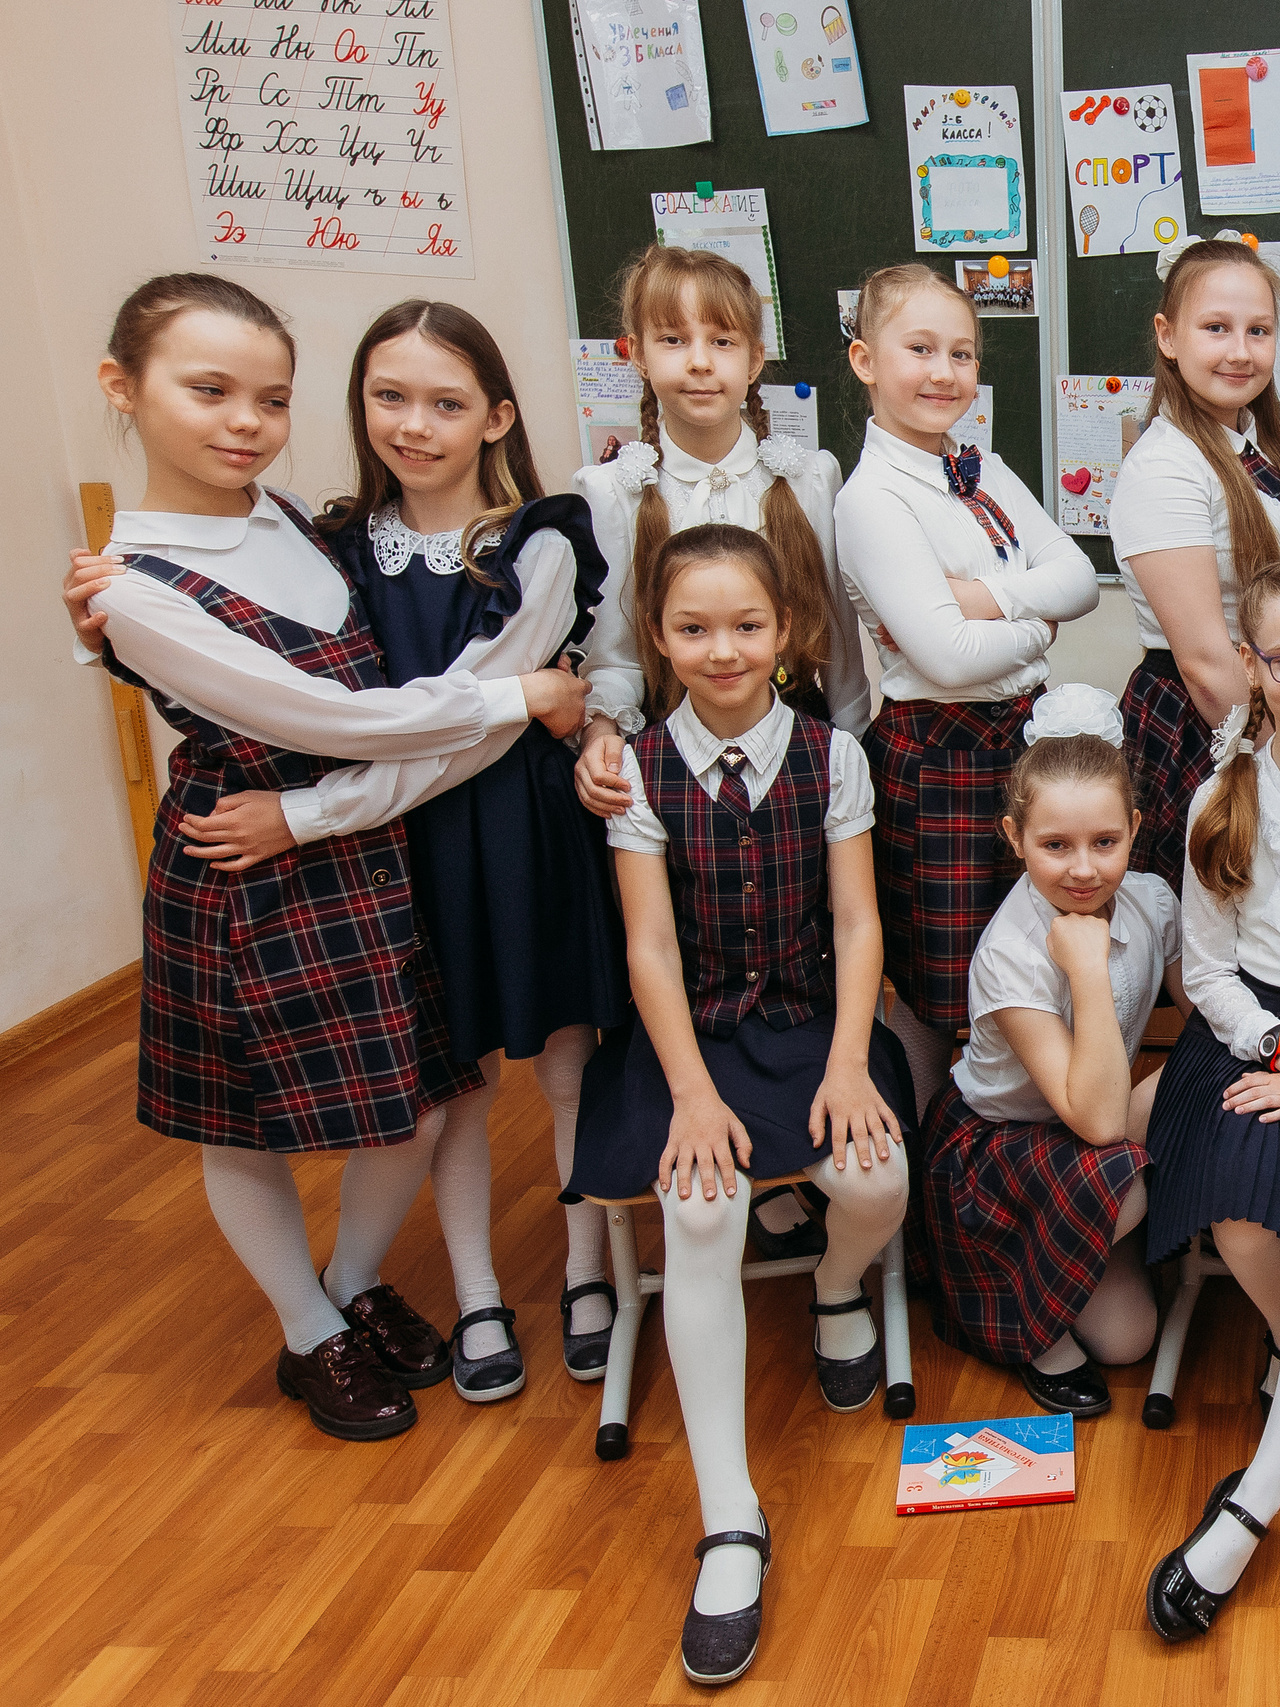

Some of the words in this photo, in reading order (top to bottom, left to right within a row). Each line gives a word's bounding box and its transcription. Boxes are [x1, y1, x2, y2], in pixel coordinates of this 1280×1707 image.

[186, 20, 251, 56] Мм
[270, 24, 315, 60] Нн
[334, 28, 369, 63] Оо
[388, 31, 439, 68] Пп
[619, 45, 631, 67] 3
[635, 44, 644, 63] Б
[190, 67, 231, 116] Рр
[259, 72, 291, 107] Сс
[318, 76, 386, 113] Тт
[413, 81, 447, 129] Уу
[200, 117, 244, 163] Фф
[263, 120, 318, 156] Хх
[339, 124, 385, 166] Цц
[407, 128, 443, 163] Чч
[208, 163, 266, 199] Шш
[285, 168, 350, 210] Щщ
[400, 191, 424, 209] ы
[1075, 152, 1175, 187] СПОРТ
[654, 192, 760, 215] СОДЕРЖАНИЕ
[214, 210, 247, 243] Ээ
[306, 216, 361, 250] Юю
[417, 223, 458, 257] Яя
[1061, 376, 1155, 395] РИСОАНИ
[976, 1433, 1038, 1468] Математика
[931, 1503, 965, 1511] Математика
